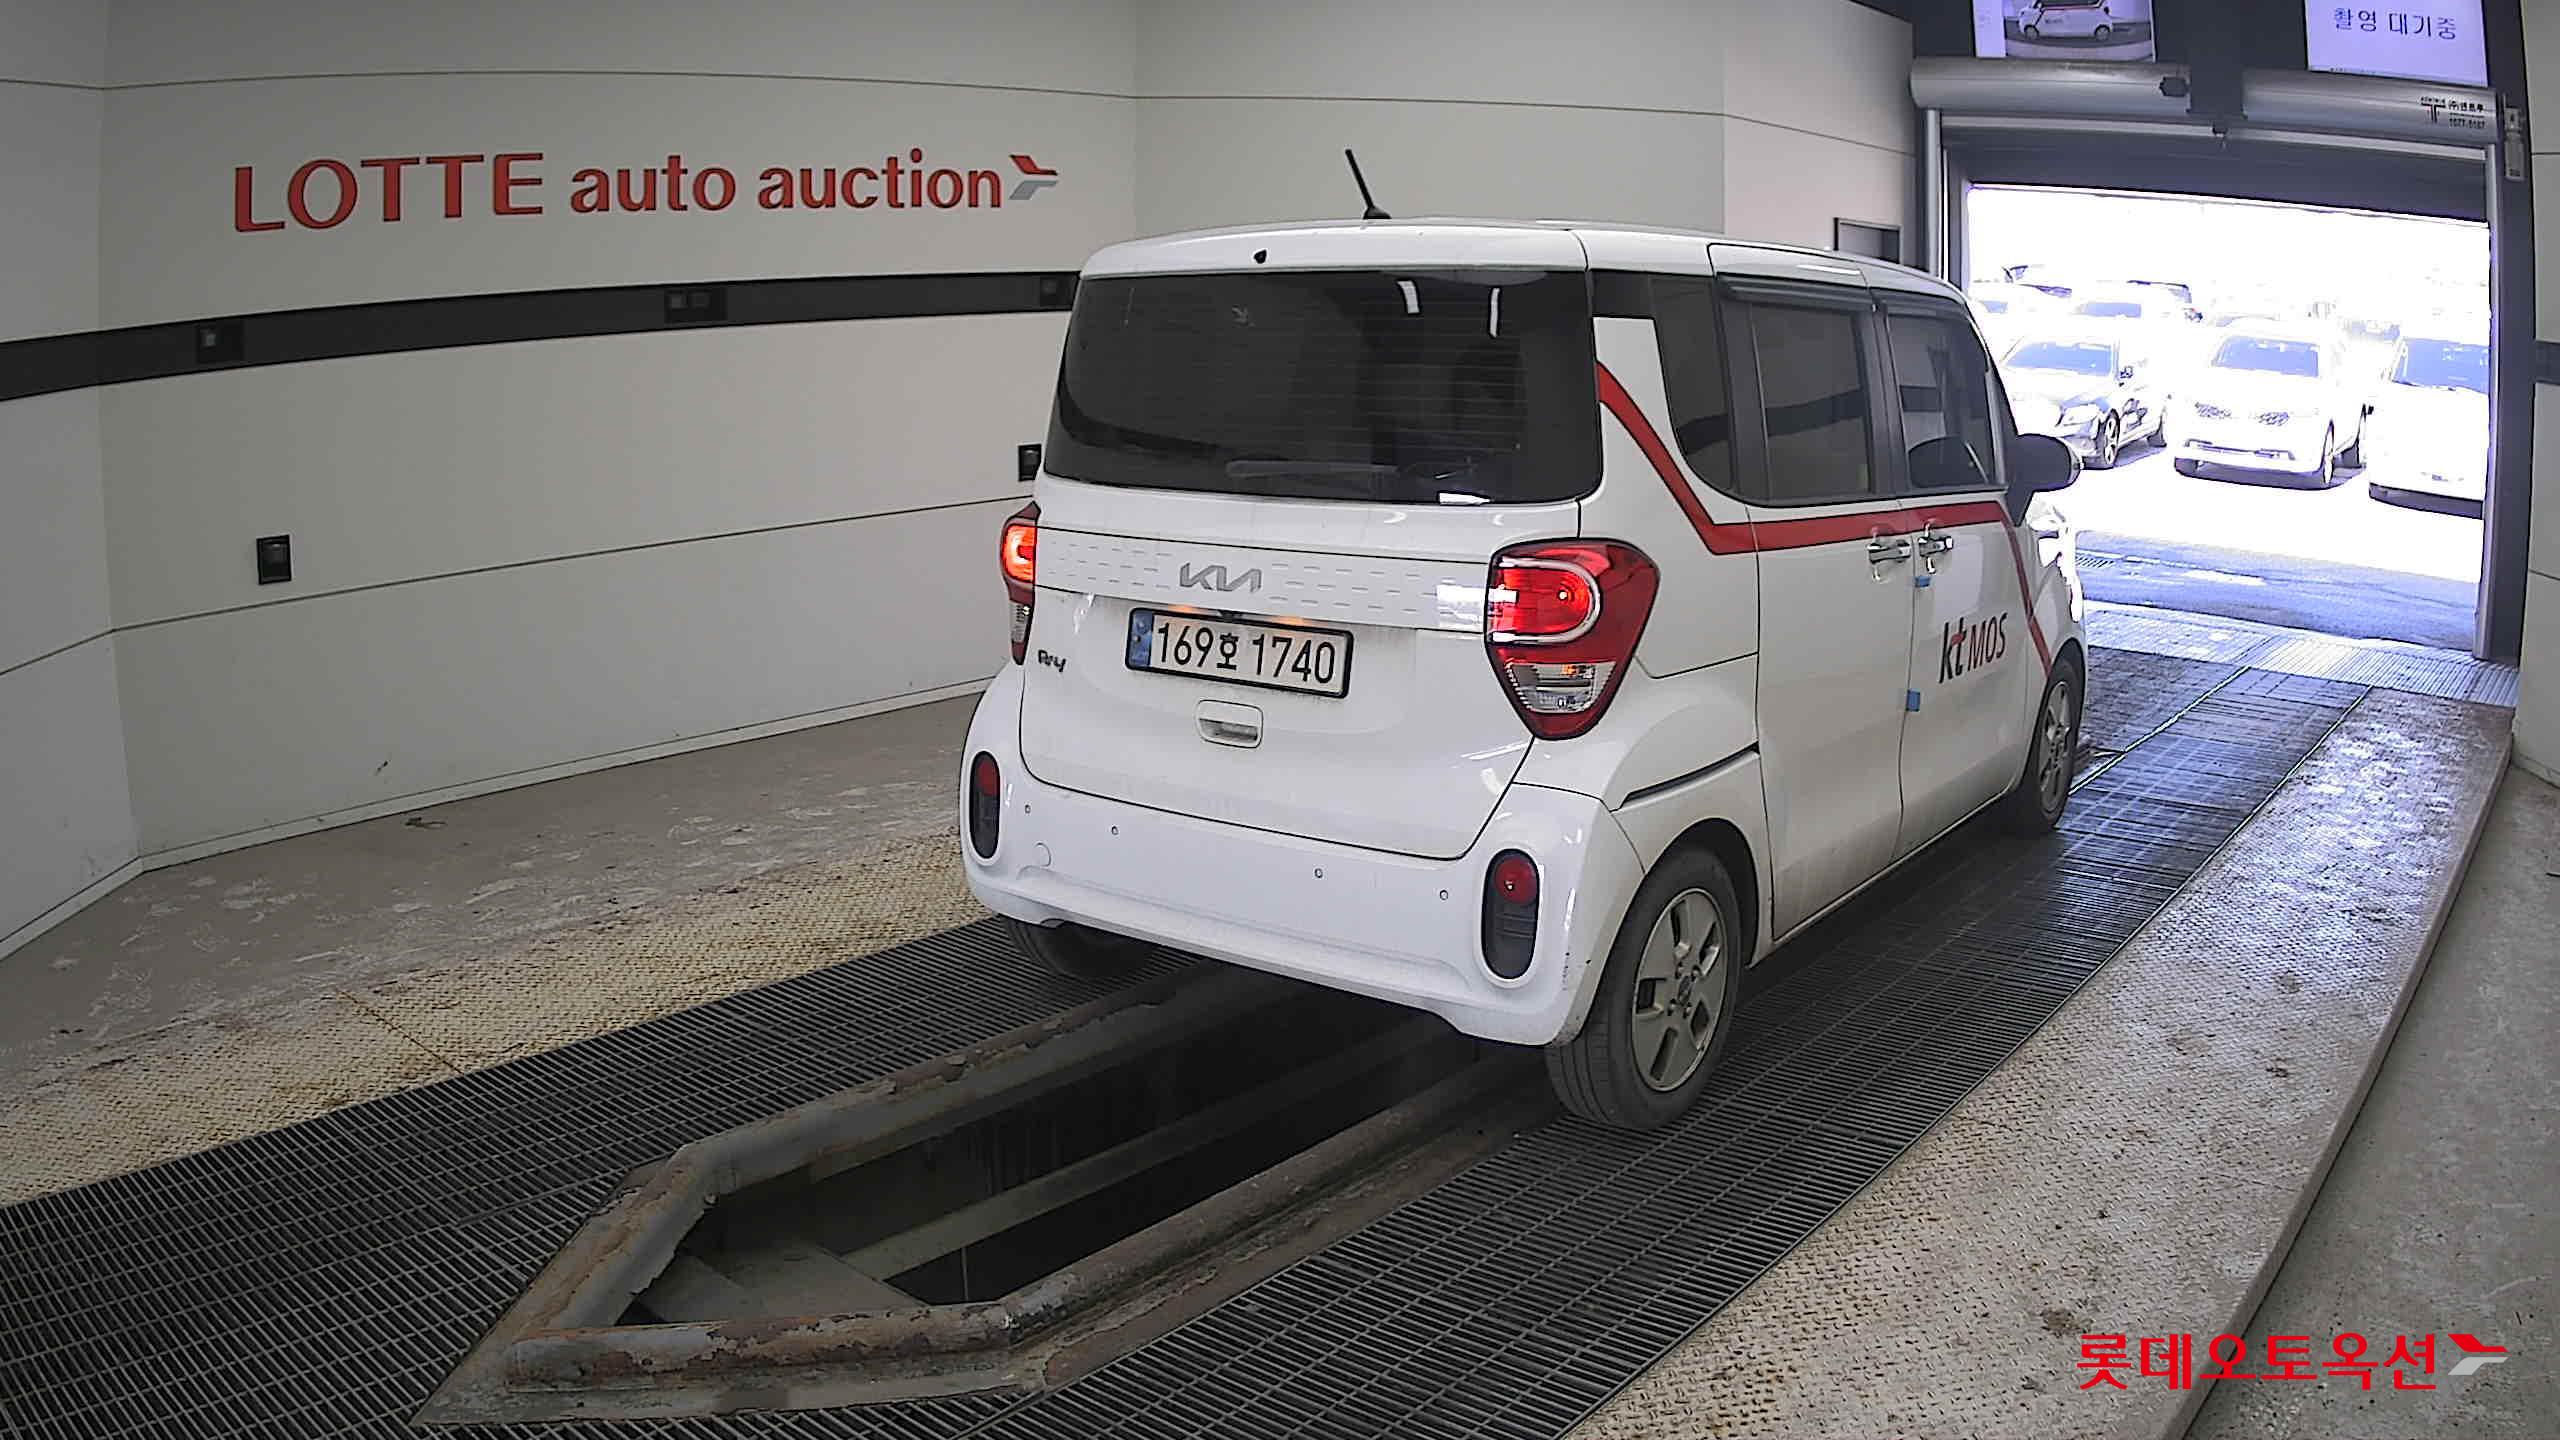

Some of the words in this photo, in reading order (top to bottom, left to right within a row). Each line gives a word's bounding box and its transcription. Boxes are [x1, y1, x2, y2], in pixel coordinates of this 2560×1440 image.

[2334, 8, 2377, 32] 촬영
[2388, 12, 2457, 40] 대기중
[234, 152, 543, 233] LOTTE
[569, 154, 737, 214] auto
[757, 147, 1003, 210] auction
[1157, 621, 1240, 671] 169호
[1251, 632, 1336, 684] 1740
[1967, 612, 2008, 672] MOS
